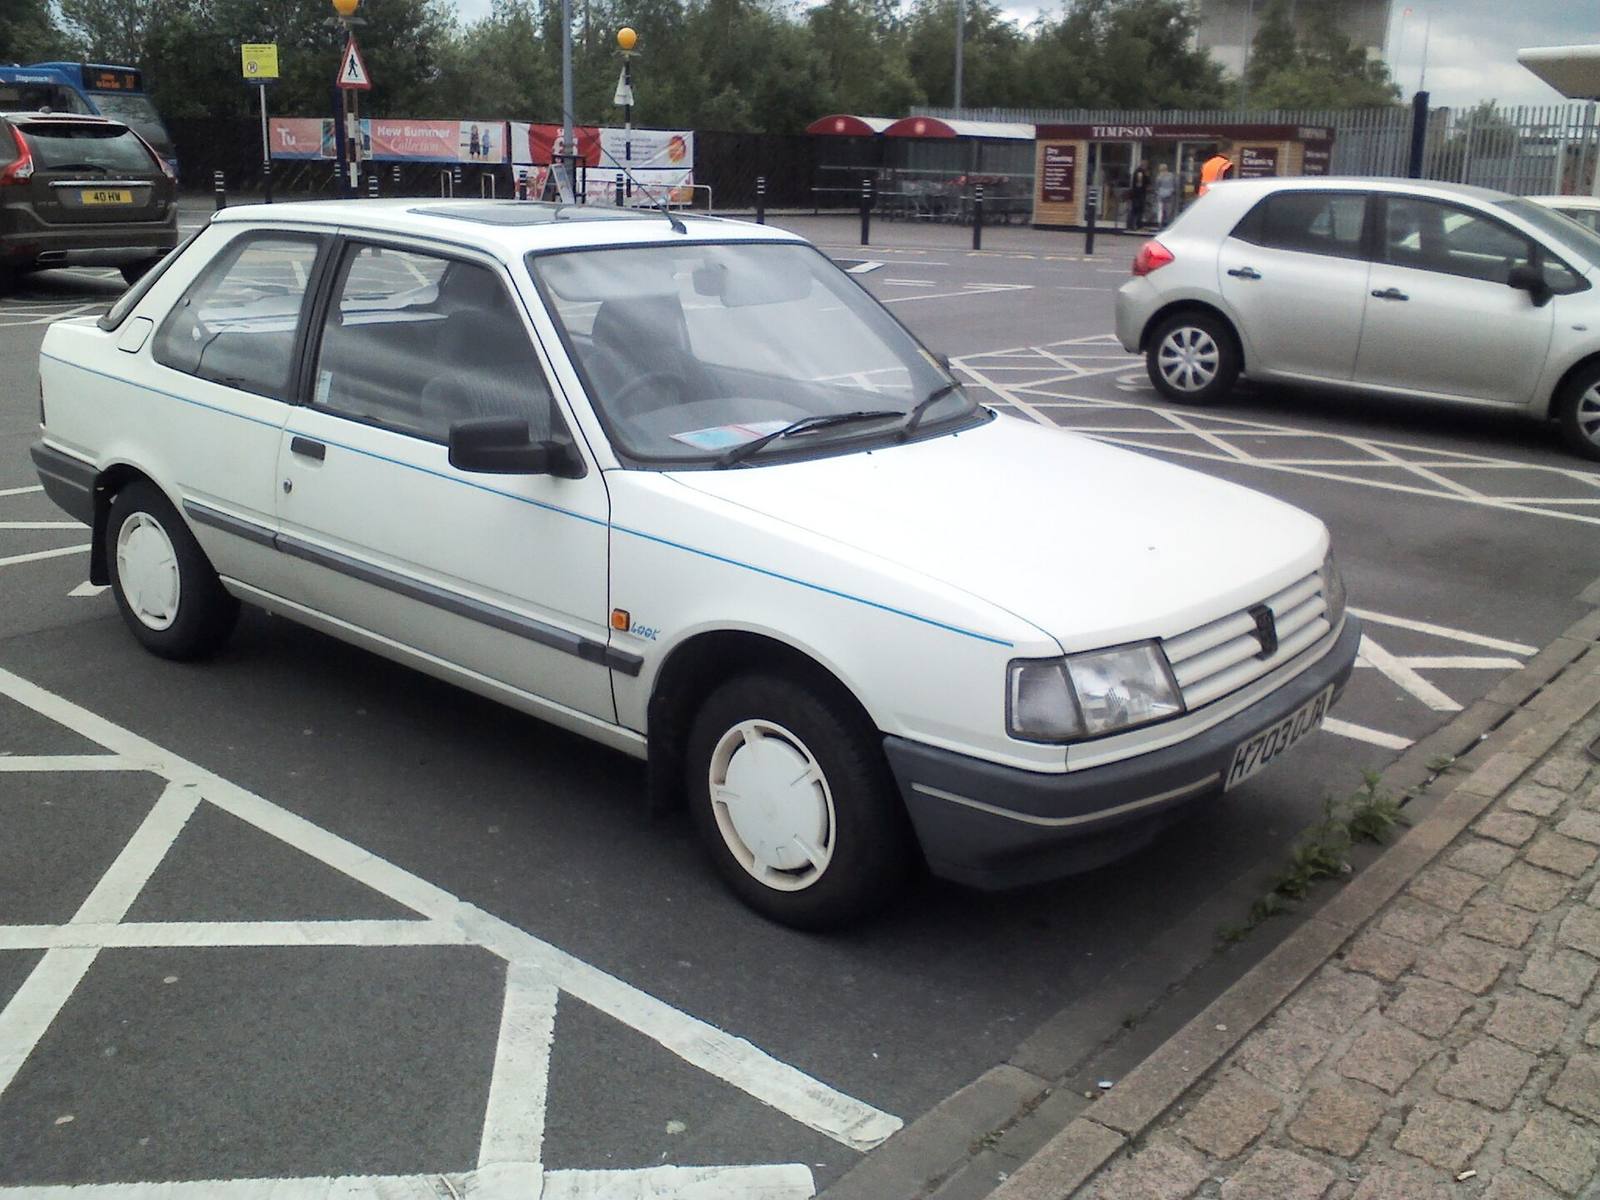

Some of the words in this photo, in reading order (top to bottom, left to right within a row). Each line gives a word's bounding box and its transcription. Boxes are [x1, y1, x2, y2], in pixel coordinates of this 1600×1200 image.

[277, 127, 296, 146] Tu
[377, 126, 401, 137] New
[404, 127, 450, 138] Summer
[1092, 126, 1153, 137] TIMPSON
